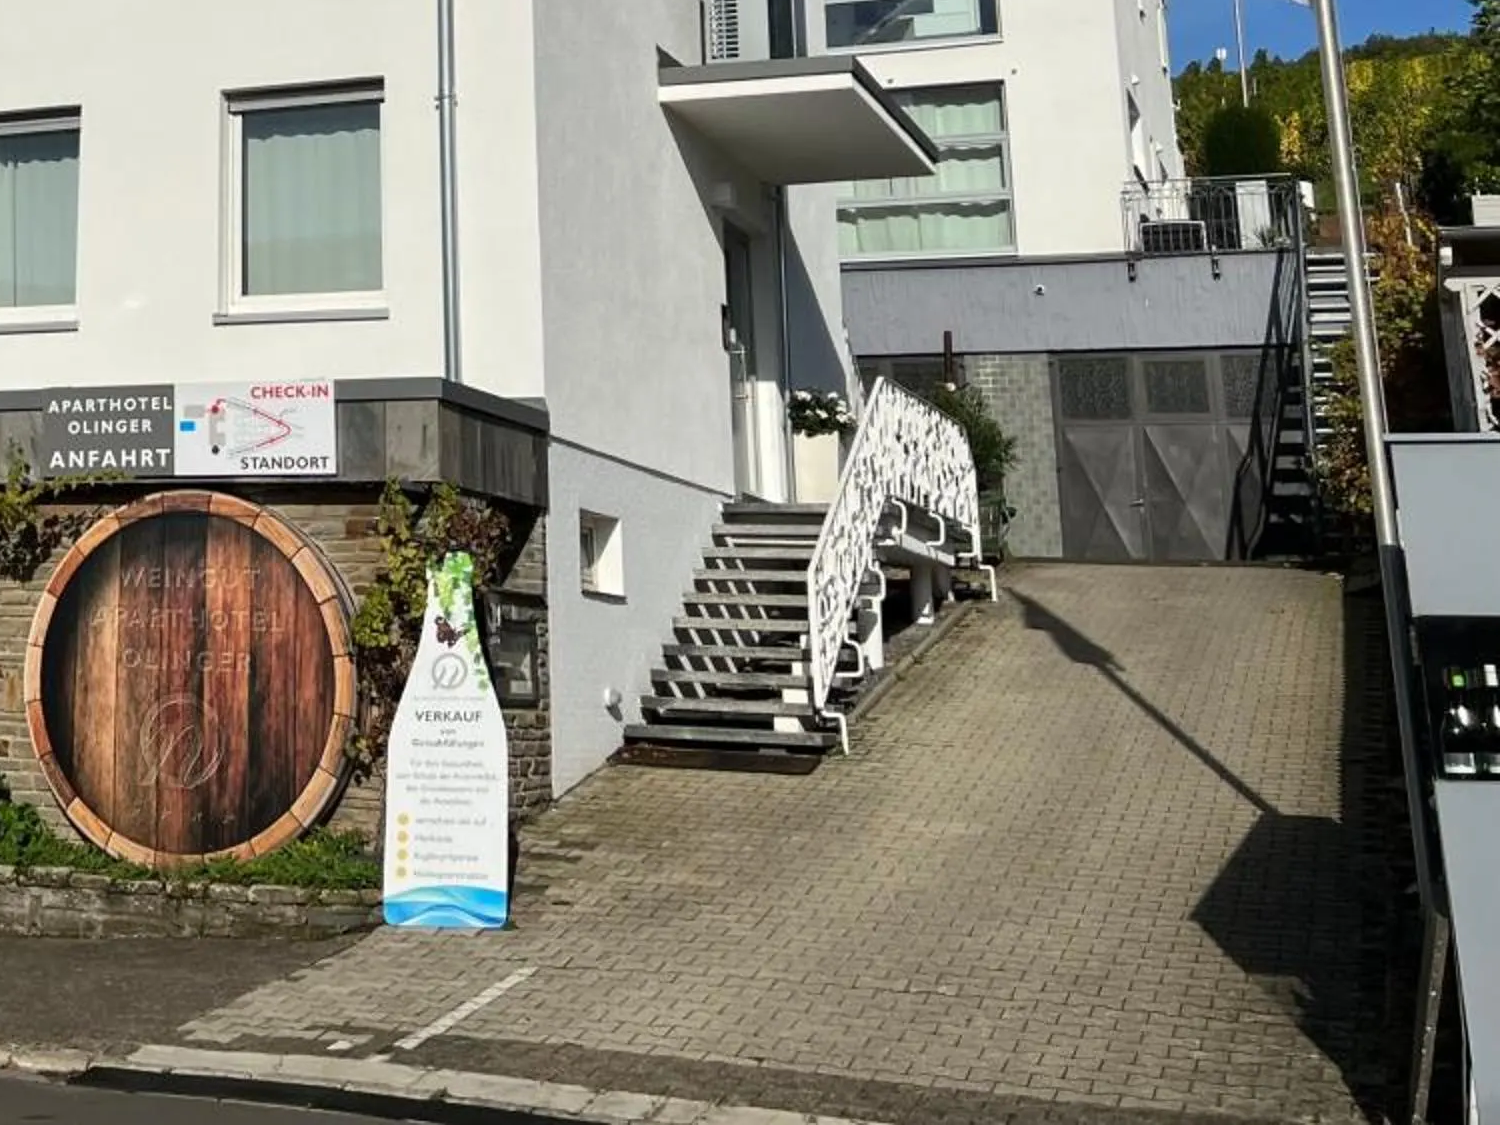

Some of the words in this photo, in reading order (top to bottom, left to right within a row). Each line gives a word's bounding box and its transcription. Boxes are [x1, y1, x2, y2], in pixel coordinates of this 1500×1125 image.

[251, 385, 329, 399] CHECK-IN
[48, 397, 172, 413] APARTHOTEL
[67, 418, 152, 434] OLINGER
[49, 449, 171, 468] ANFAHRT
[240, 456, 329, 470] STANDORT
[121, 566, 260, 589] WEINGUT
[123, 647, 251, 672] OLINGER
[415, 710, 483, 723] VERKAUF
